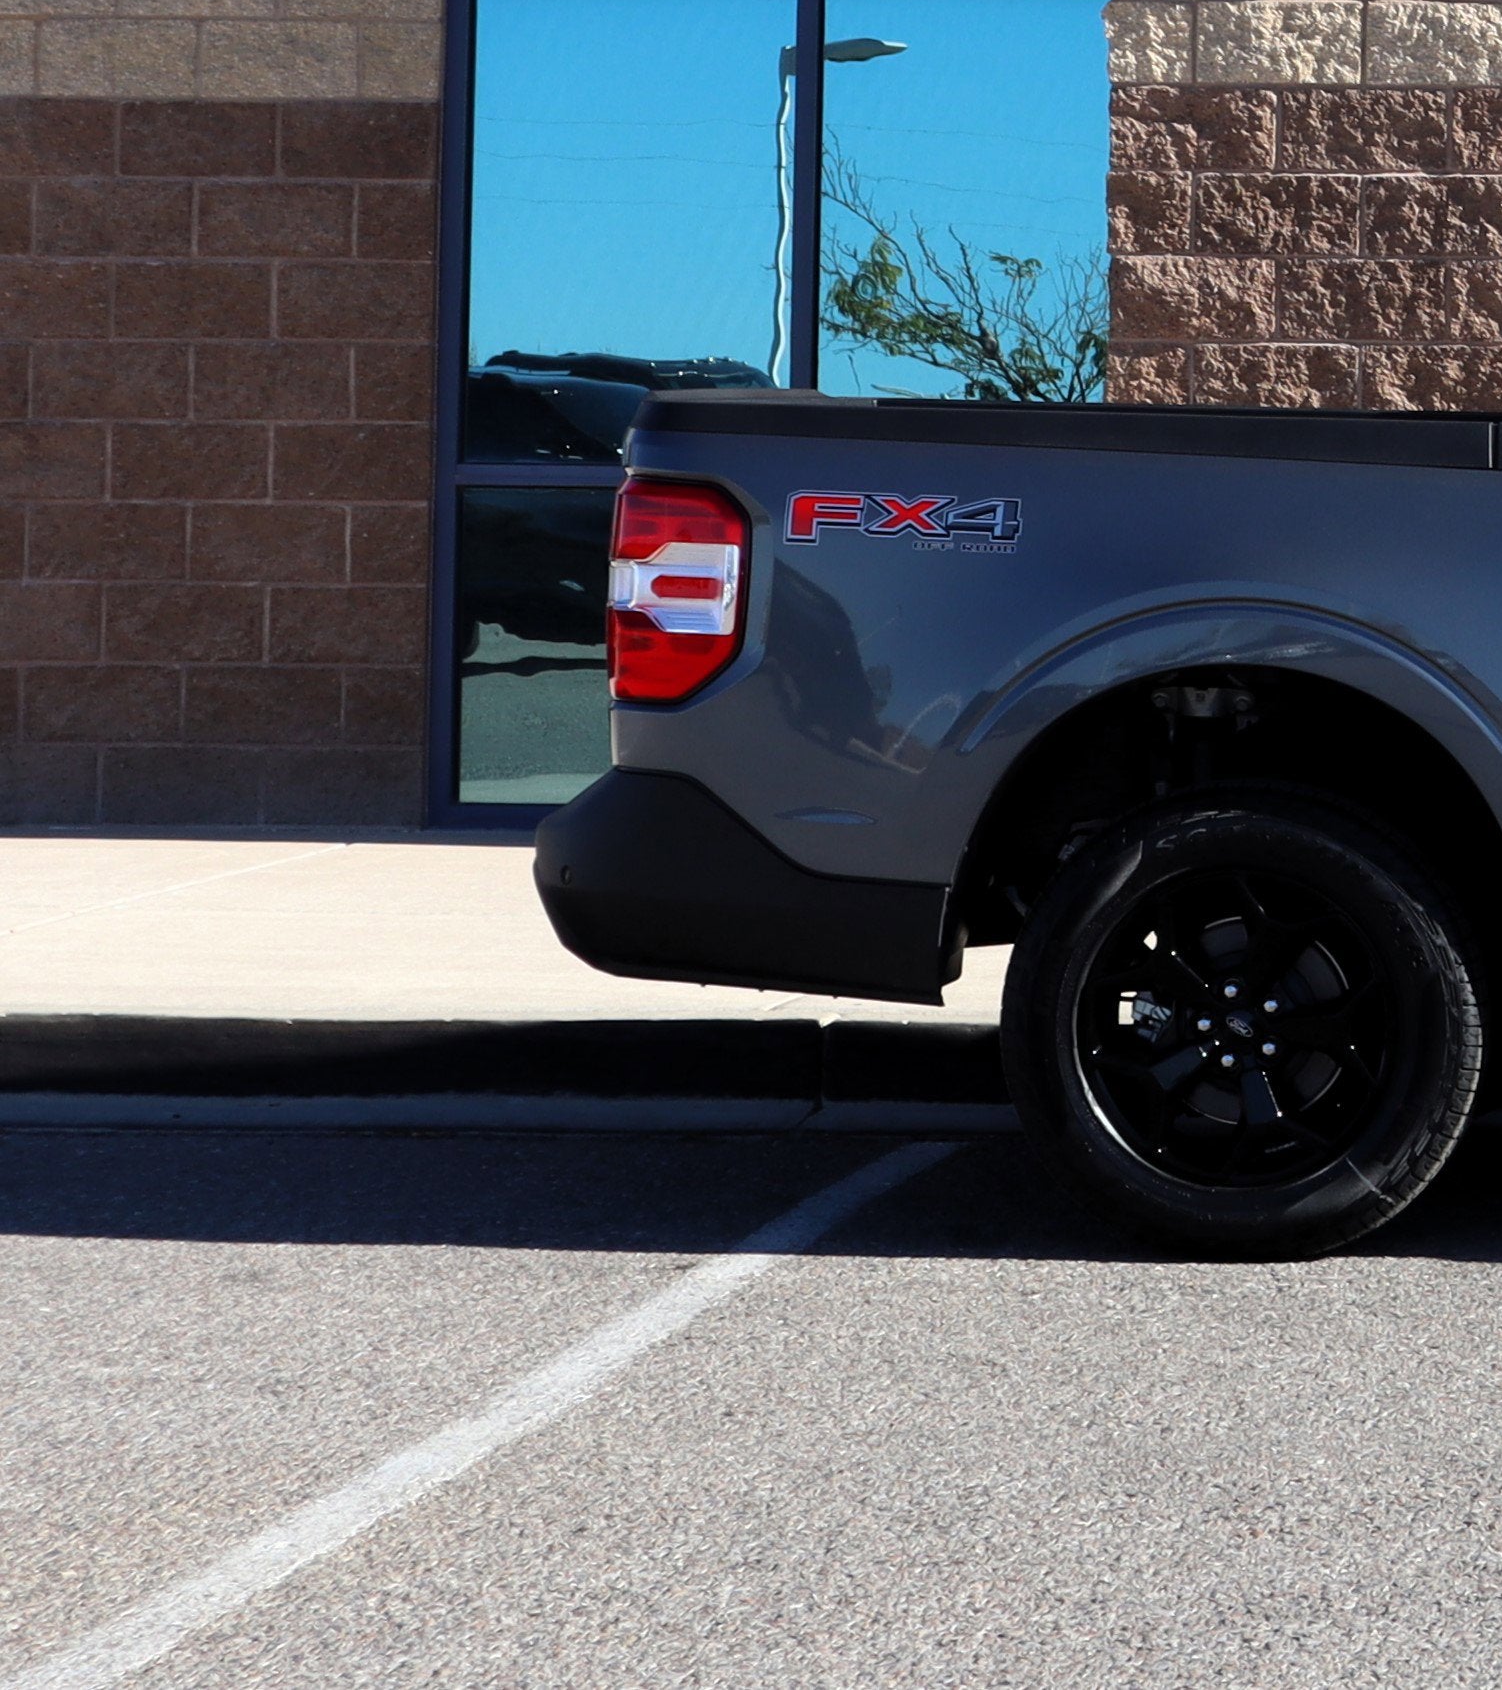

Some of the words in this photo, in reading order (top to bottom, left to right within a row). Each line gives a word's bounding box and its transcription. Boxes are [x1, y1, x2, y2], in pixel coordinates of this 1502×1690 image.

[784, 489, 1023, 545] FX4
[912, 541, 954, 552] OFF
[960, 542, 1017, 554] ROAD
